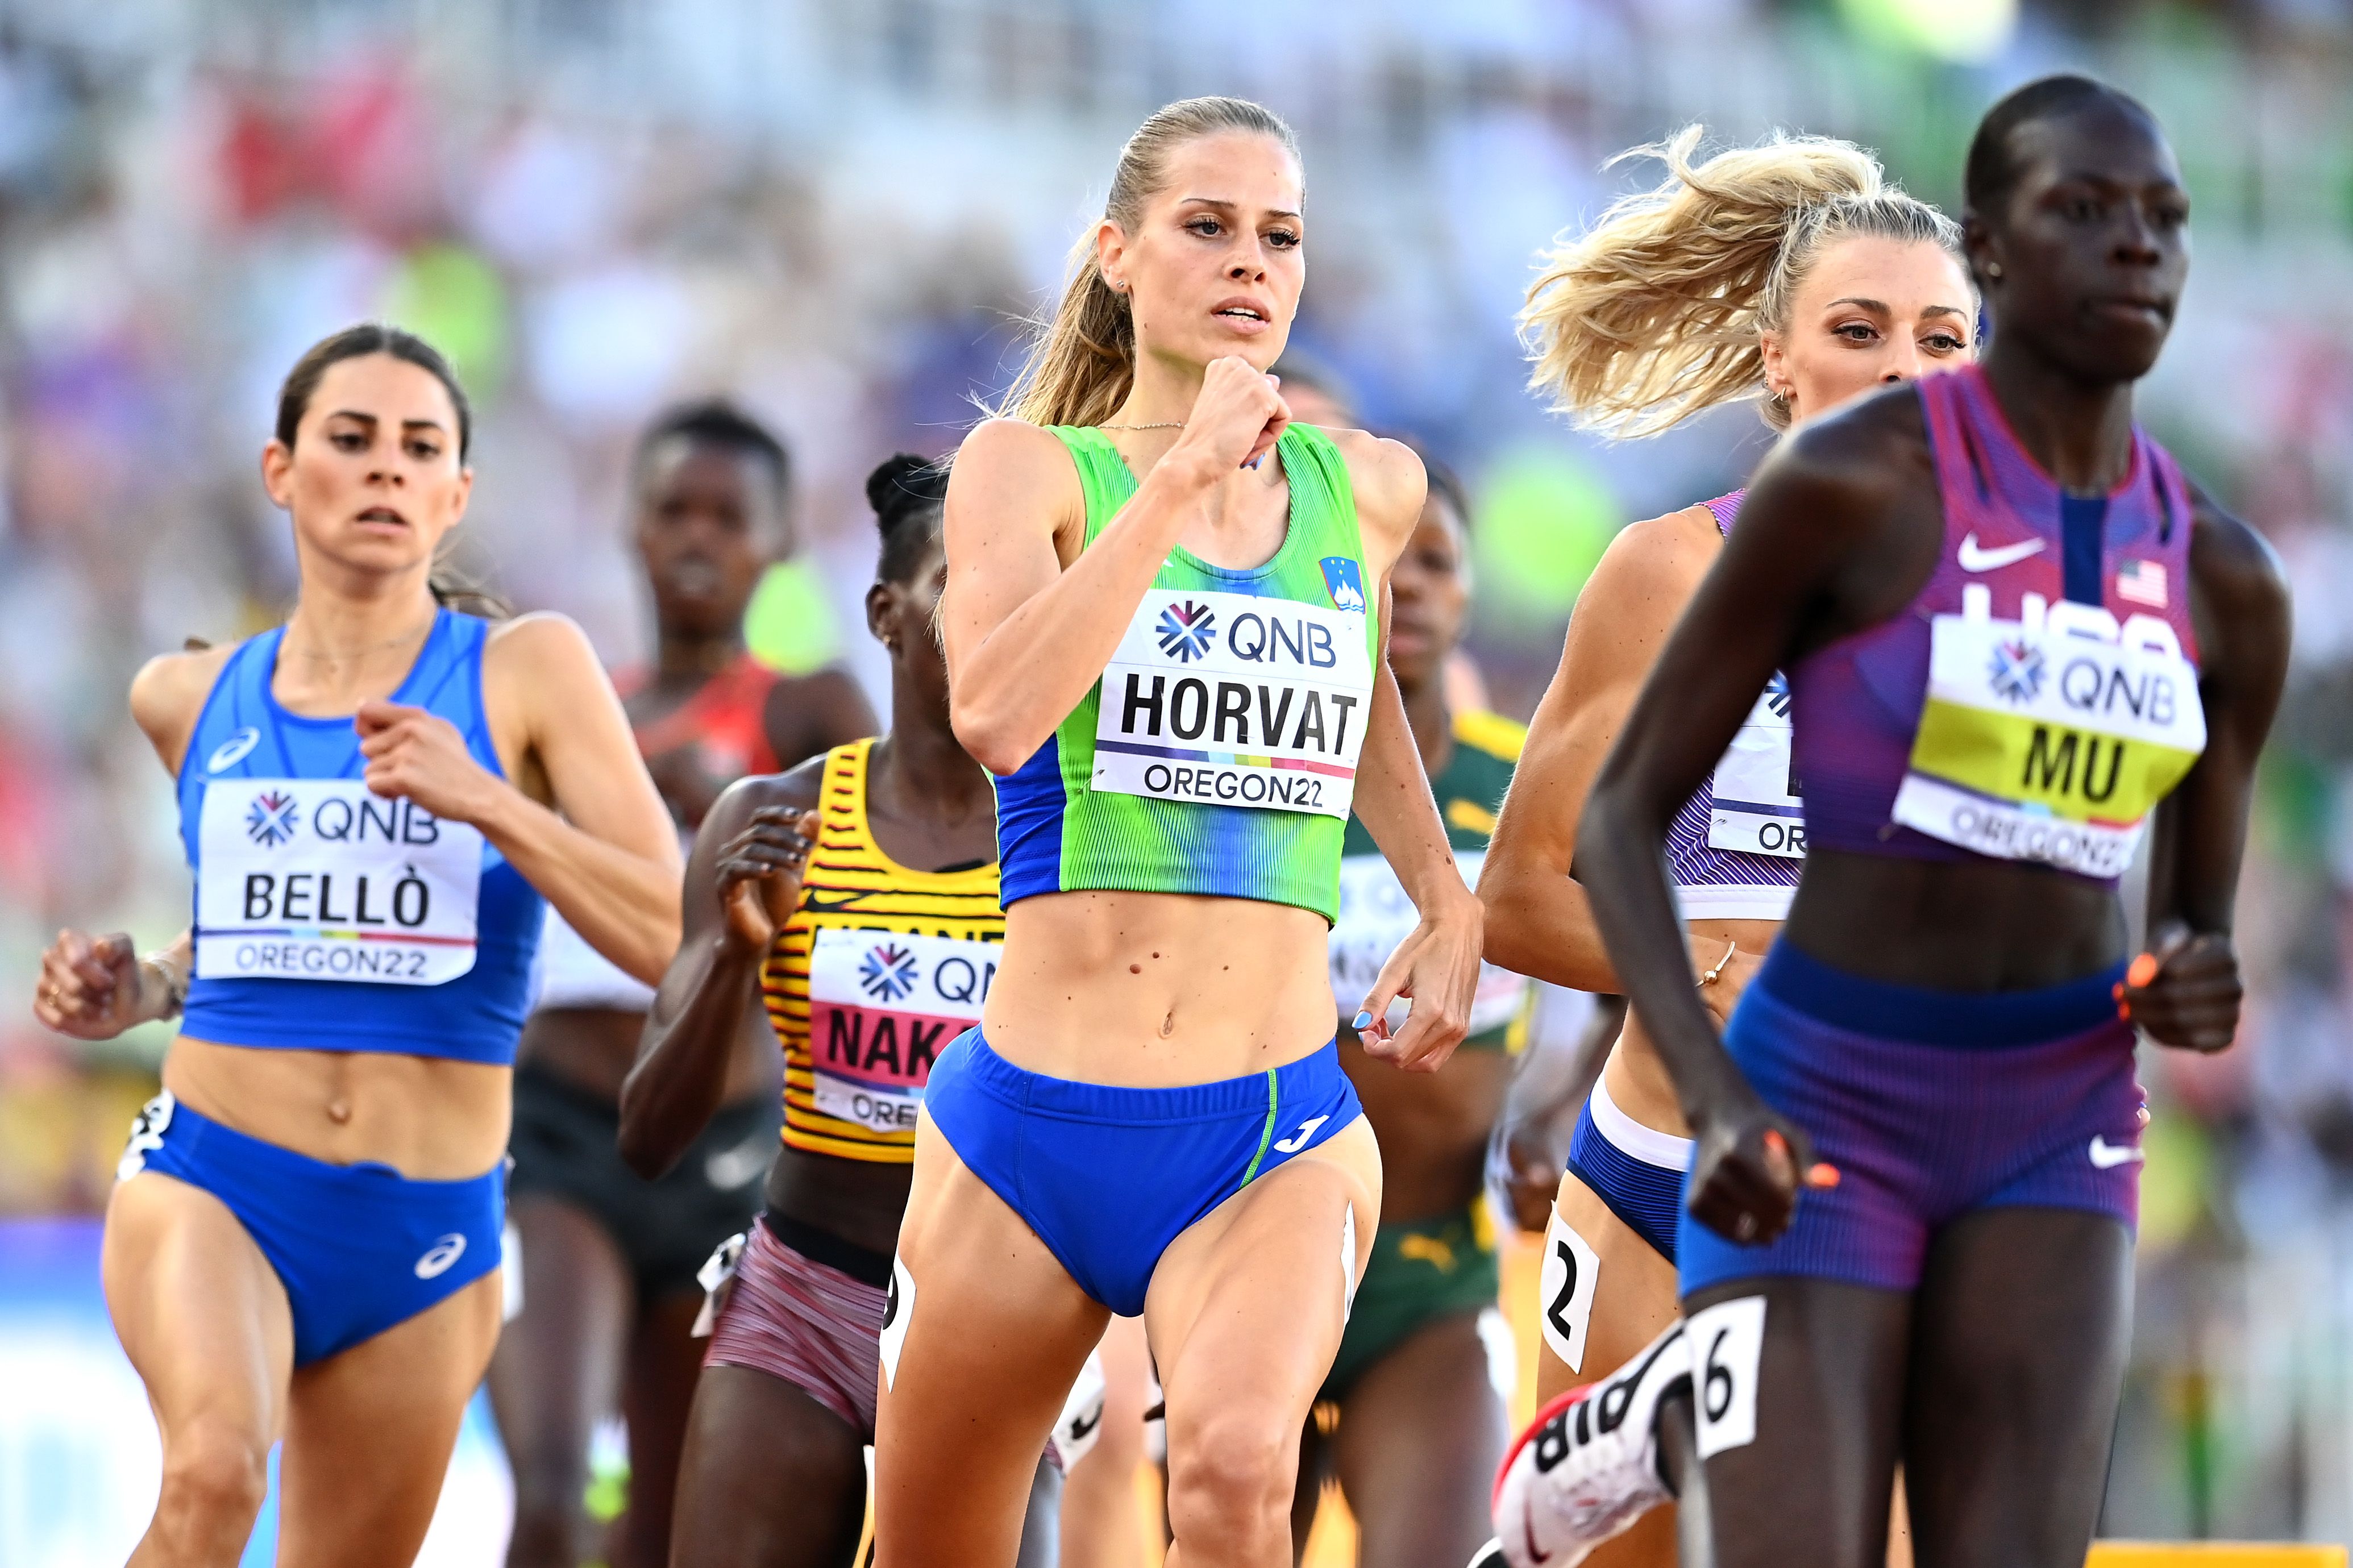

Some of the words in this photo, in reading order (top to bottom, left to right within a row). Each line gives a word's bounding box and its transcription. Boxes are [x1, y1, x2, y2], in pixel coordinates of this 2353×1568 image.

[1228, 613, 1337, 669] QNB
[1121, 673, 1357, 756] HORVAT
[2060, 656, 2176, 727] QNB
[1144, 764, 1323, 809] OREGON22
[2022, 723, 2125, 804] MU
[314, 797, 439, 845] QNB
[244, 863, 430, 928] BELLÒ
[236, 944, 427, 978] OREGON22
[1547, 1240, 1577, 1341] 2
[1705, 1326, 1731, 1423] 6
